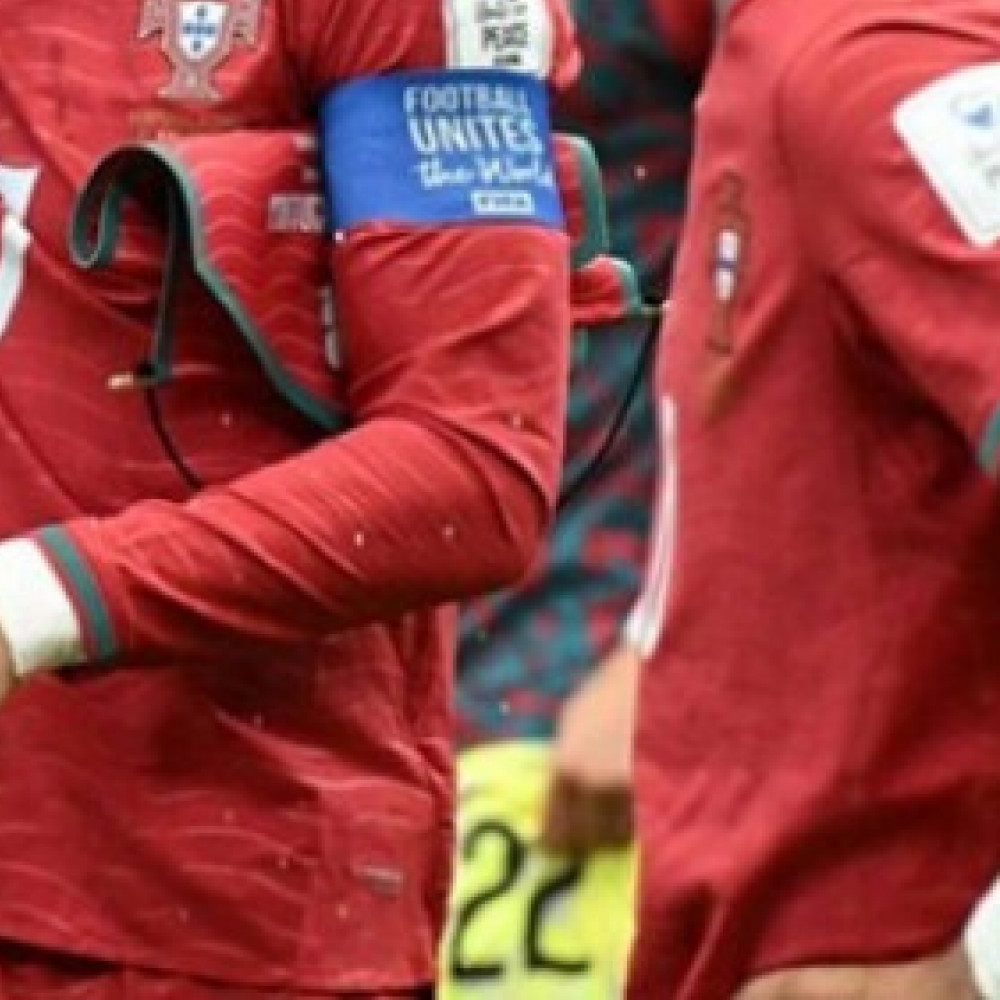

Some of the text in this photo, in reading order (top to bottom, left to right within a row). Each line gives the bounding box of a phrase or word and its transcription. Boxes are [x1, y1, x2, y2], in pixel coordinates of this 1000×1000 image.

[403, 84, 529, 113] FOOTBALL
[409, 115, 543, 153] UNITES
[452, 816, 592, 982] 22
